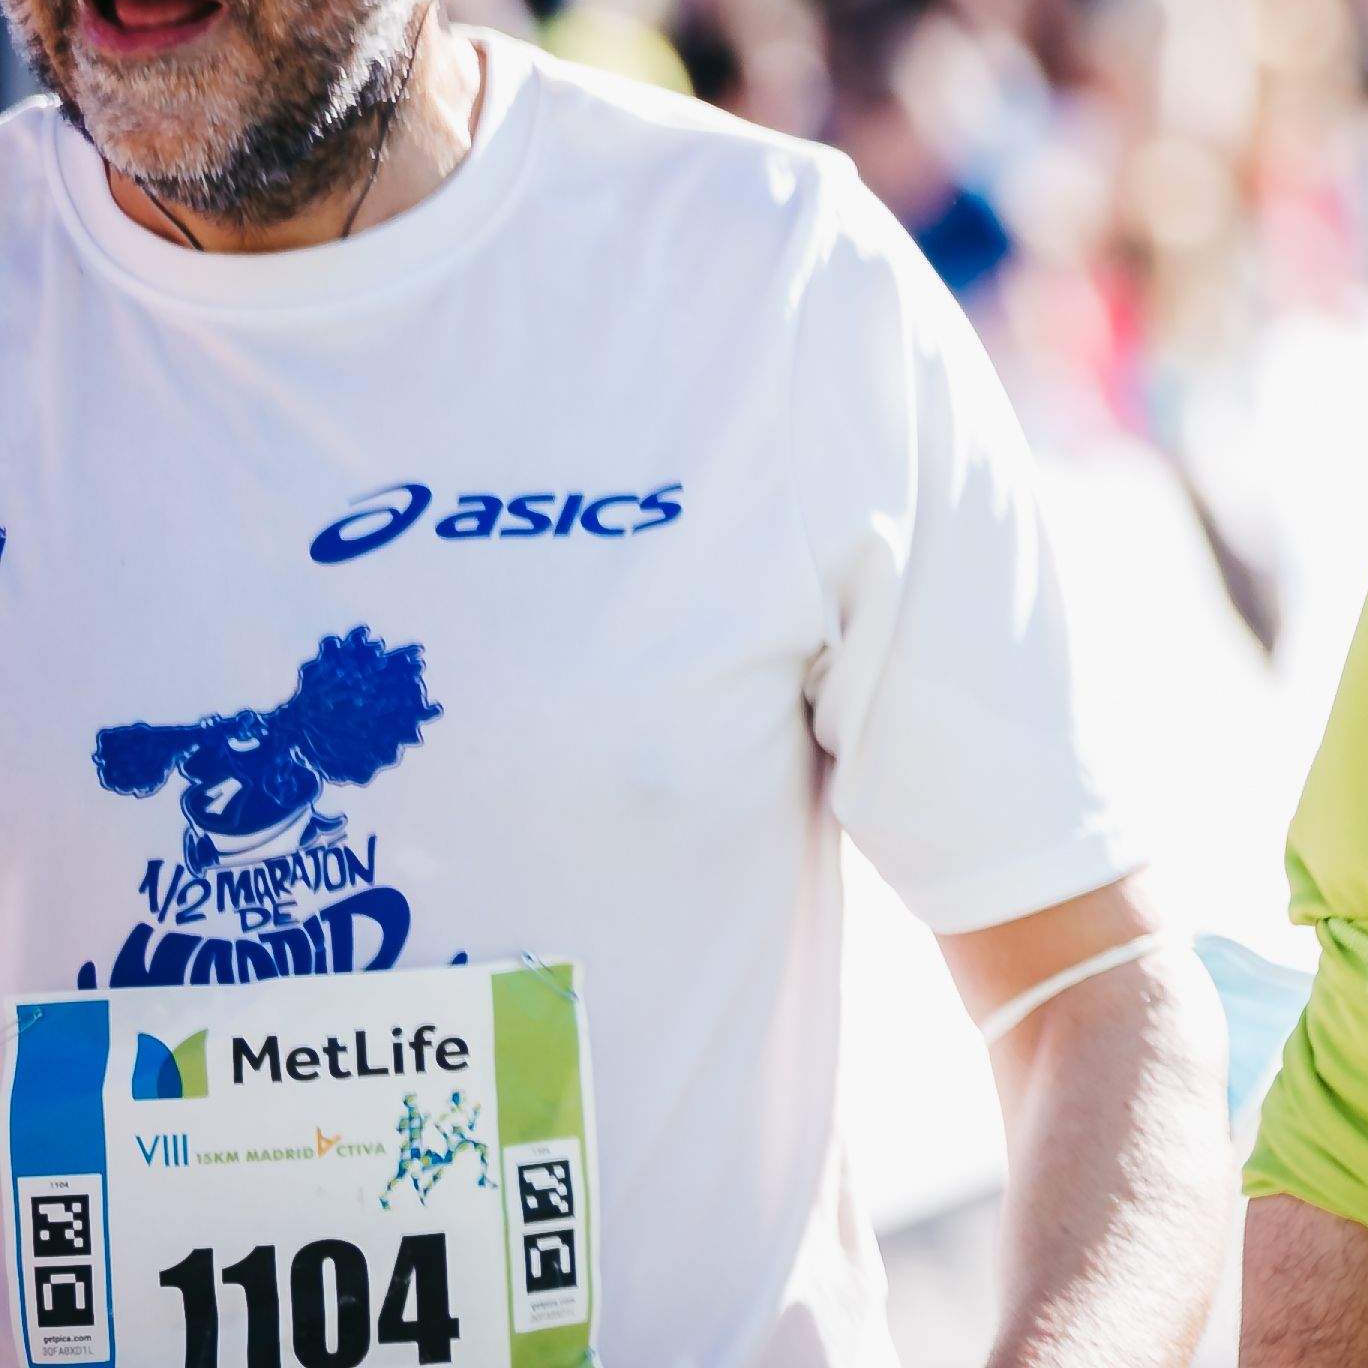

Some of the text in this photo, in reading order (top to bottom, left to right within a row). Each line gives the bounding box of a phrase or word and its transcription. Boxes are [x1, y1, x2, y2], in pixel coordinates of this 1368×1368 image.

[434, 482, 684, 539] asics
[139, 858, 208, 925] 1/2
[239, 901, 299, 934] DE
[231, 1024, 470, 1085] MetLife
[135, 1133, 191, 1167] VIII
[158, 1232, 461, 1368] 1104
